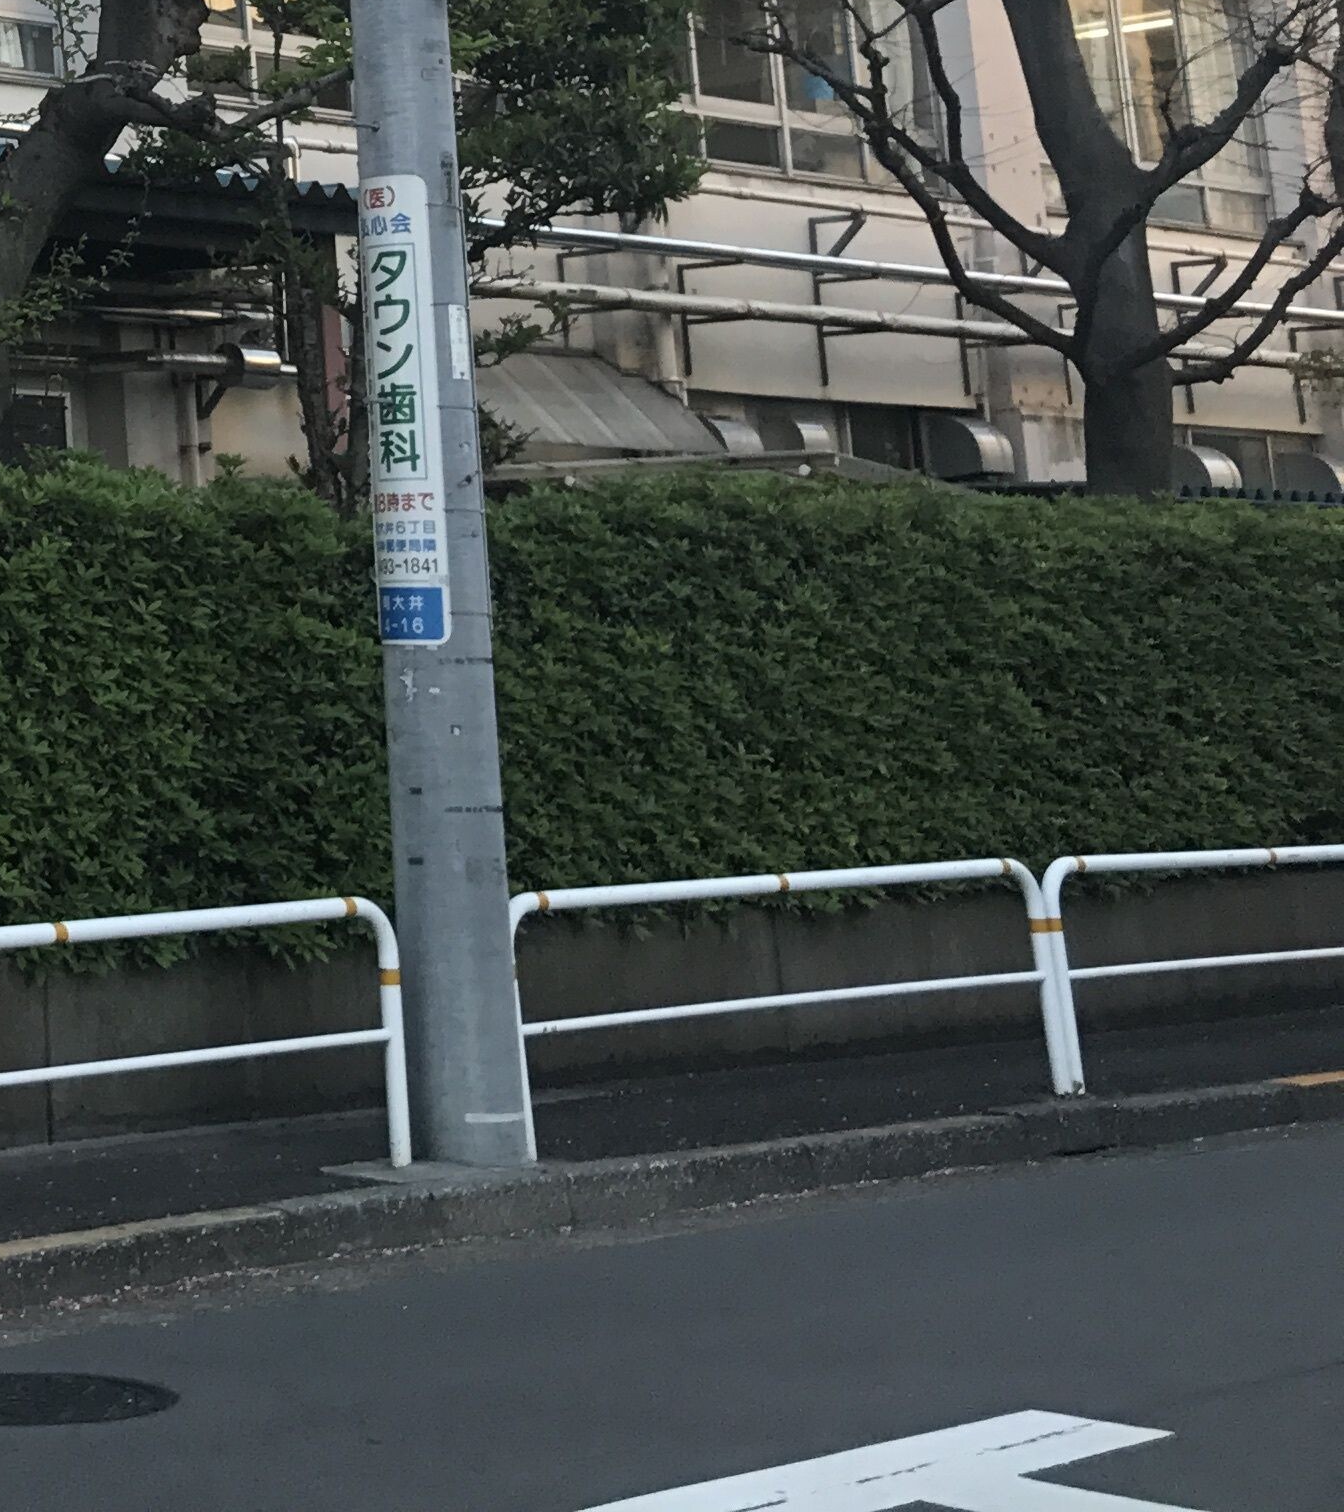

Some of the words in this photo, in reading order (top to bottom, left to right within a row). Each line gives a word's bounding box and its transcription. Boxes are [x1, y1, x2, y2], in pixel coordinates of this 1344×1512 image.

[370, 249, 421, 474] タウン歯科
